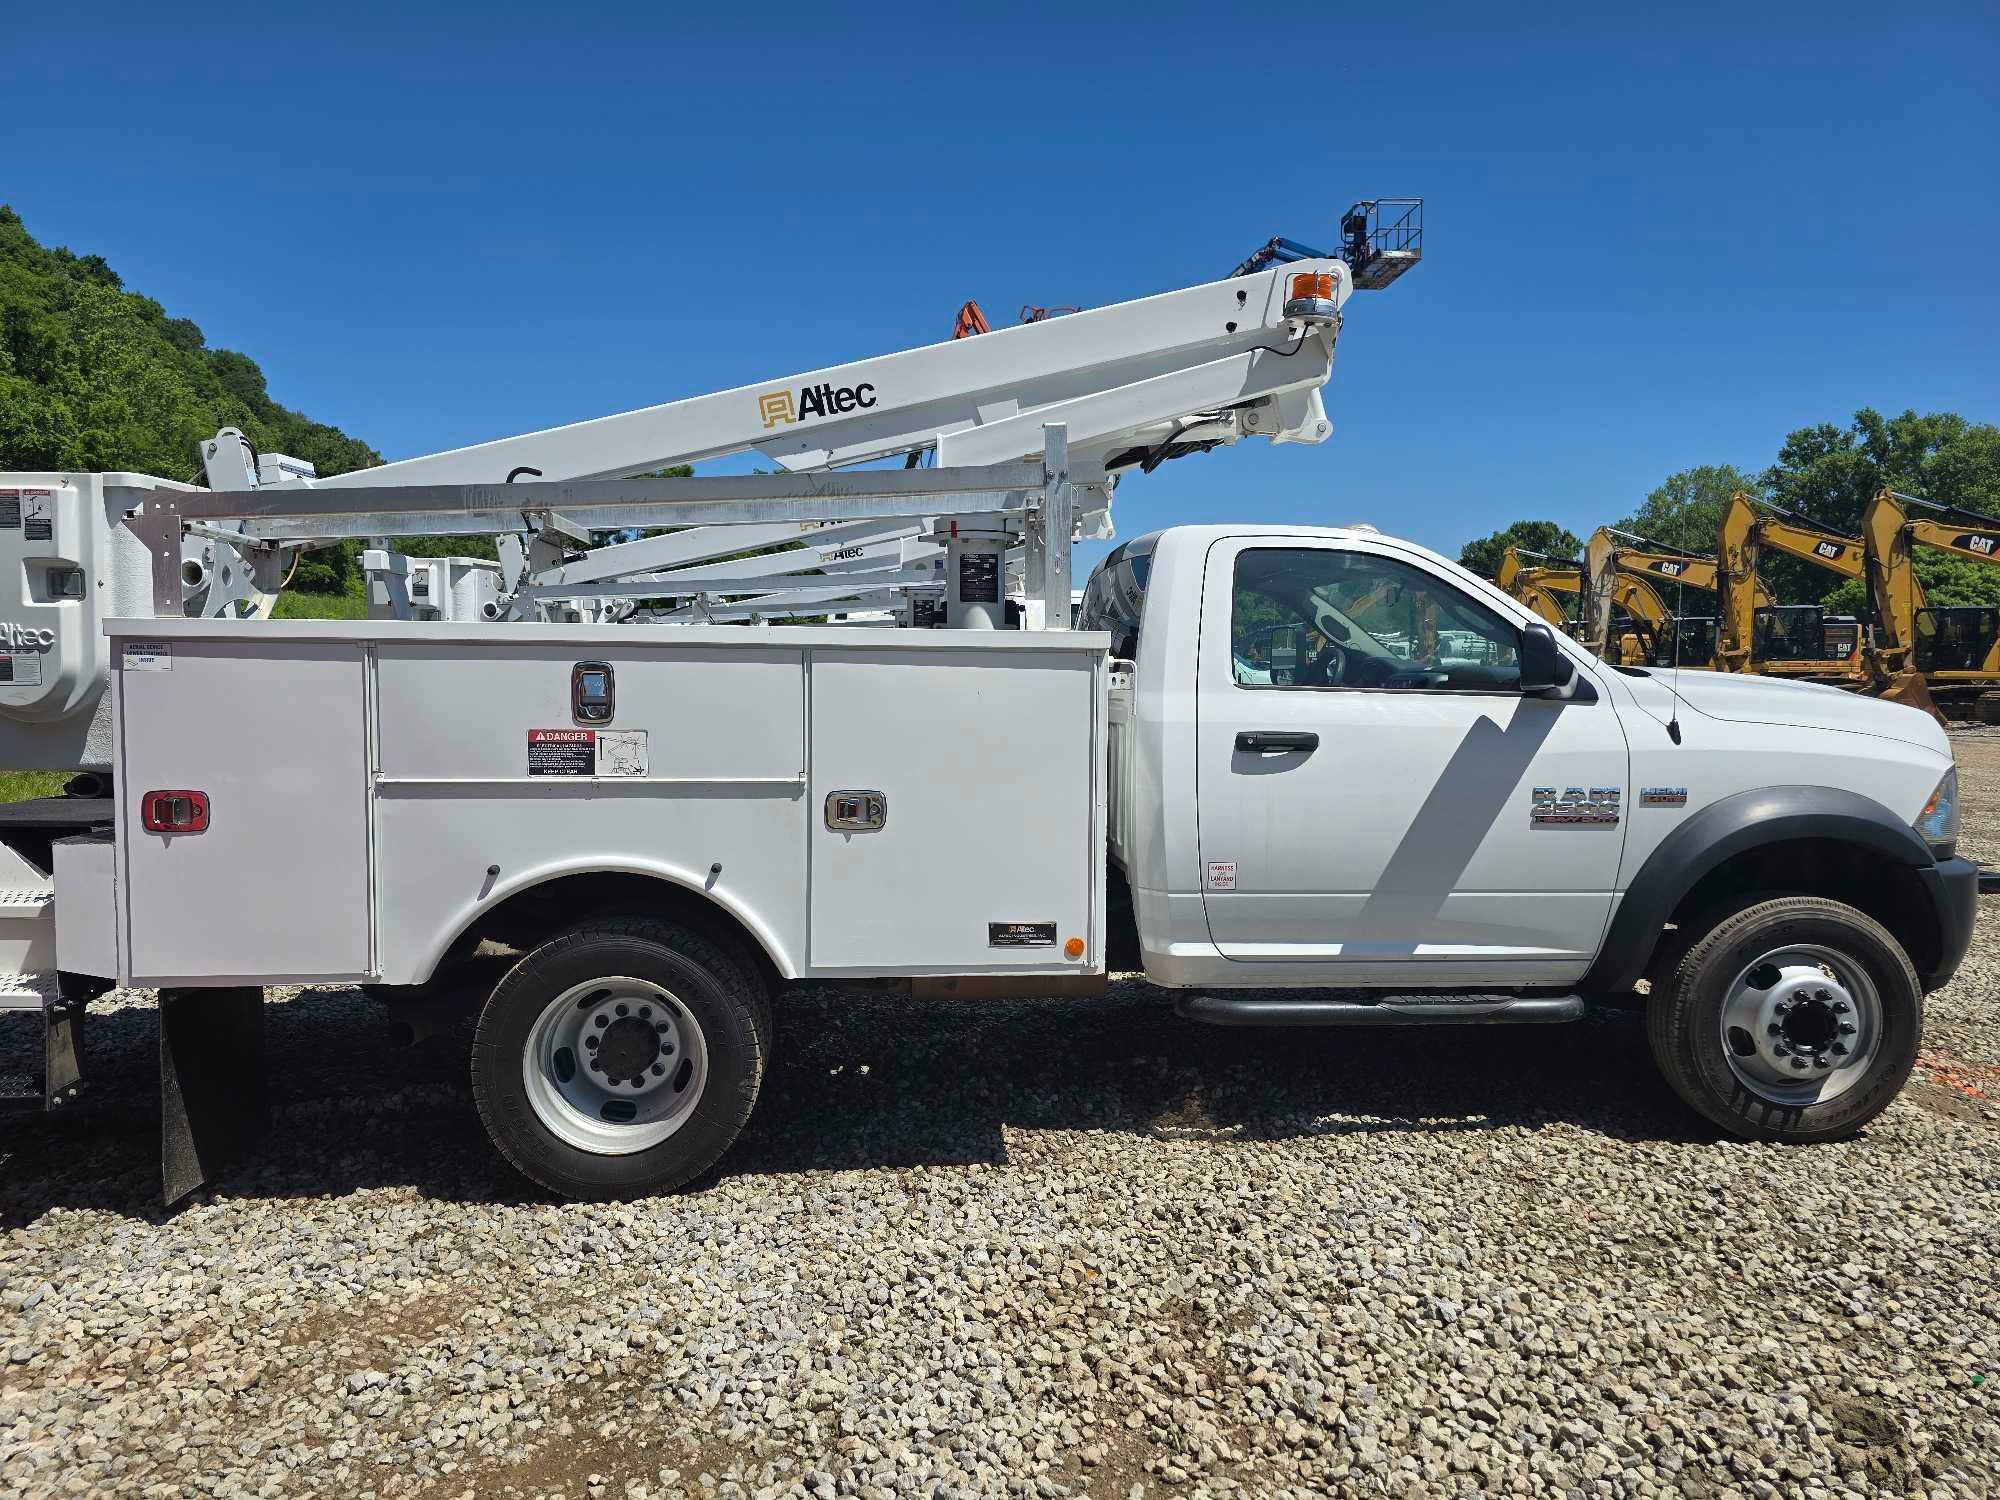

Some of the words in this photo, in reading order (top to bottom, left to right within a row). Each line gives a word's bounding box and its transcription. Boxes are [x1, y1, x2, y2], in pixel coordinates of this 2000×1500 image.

[798, 382, 877, 421] Altec
[1818, 542, 1838, 559] CAT
[1969, 535, 1994, 555] CAT
[834, 547, 864, 560] Altec
[1661, 562, 1680, 576] CAT
[1837, 643, 1852, 651] CAT
[546, 732, 588, 741] DANGER
[1533, 786, 1621, 801] RAM
[1016, 925, 1034, 933] Altec
